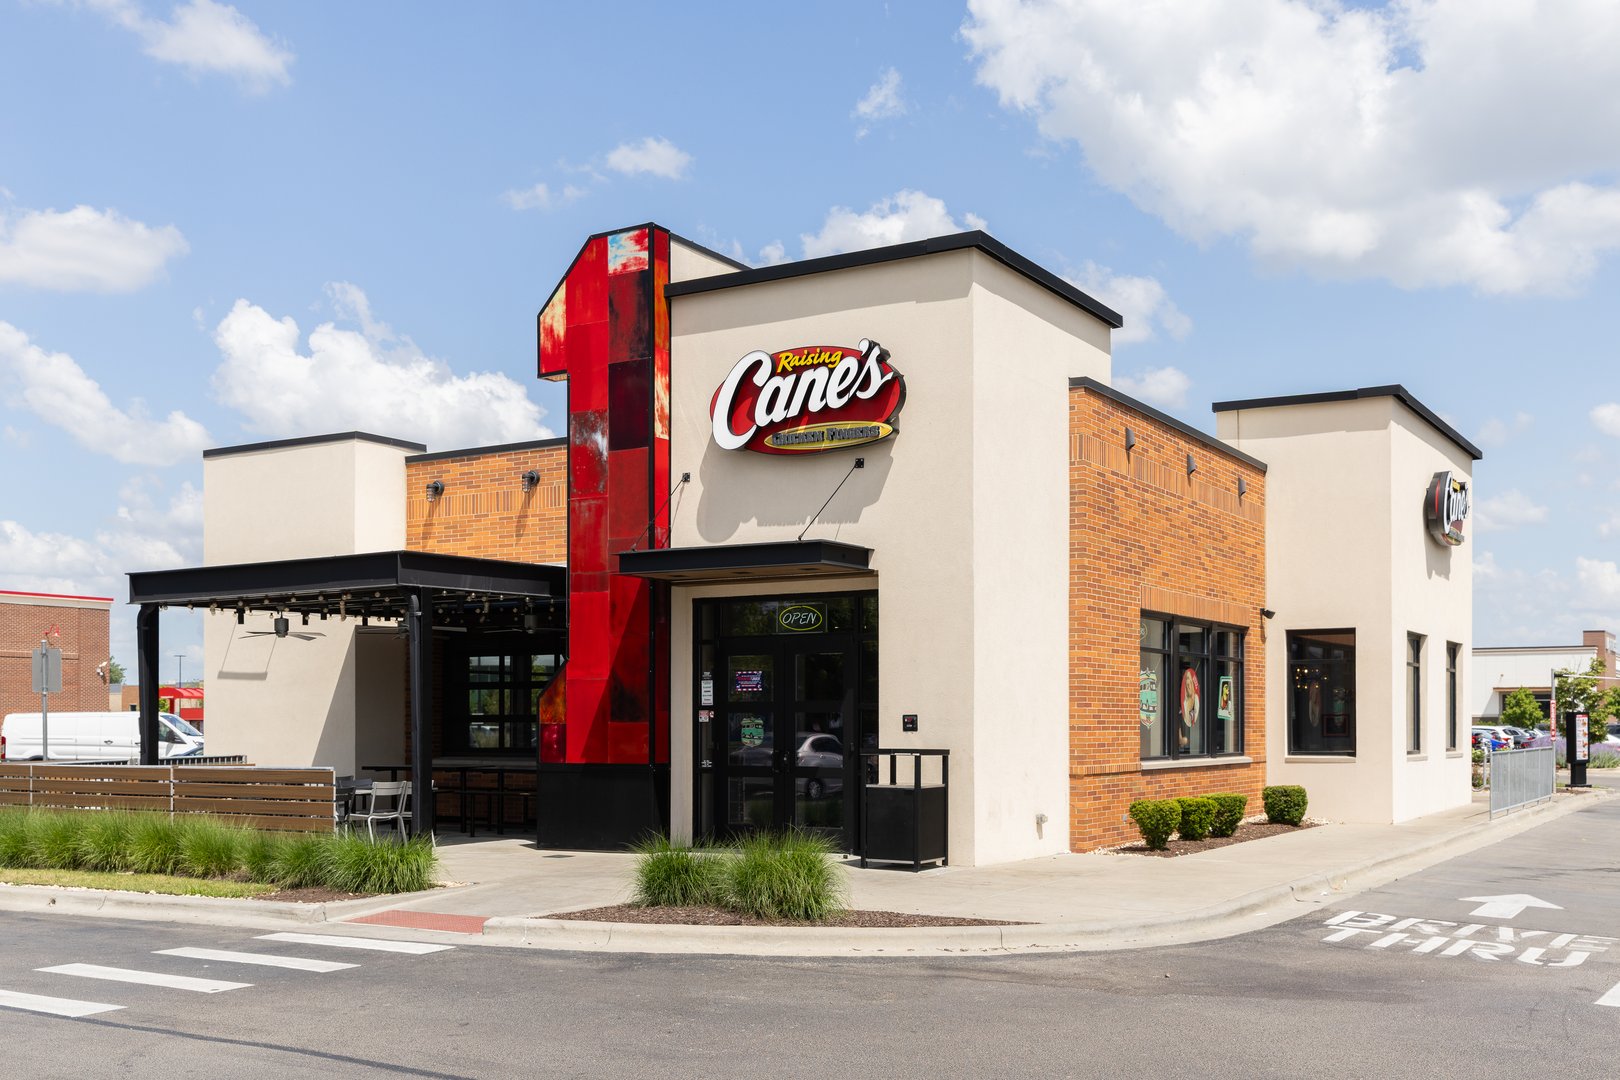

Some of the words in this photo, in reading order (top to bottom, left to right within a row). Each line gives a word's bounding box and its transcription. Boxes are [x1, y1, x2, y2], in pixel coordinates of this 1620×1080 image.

[776, 348, 842, 373] Raising
[712, 338, 894, 450] Cane's
[772, 430, 825, 446] CHICKEN
[782, 612, 817, 625] OPEN
[1320, 925, 1591, 967] THRU
[1322, 910, 1620, 953] DRIVE
